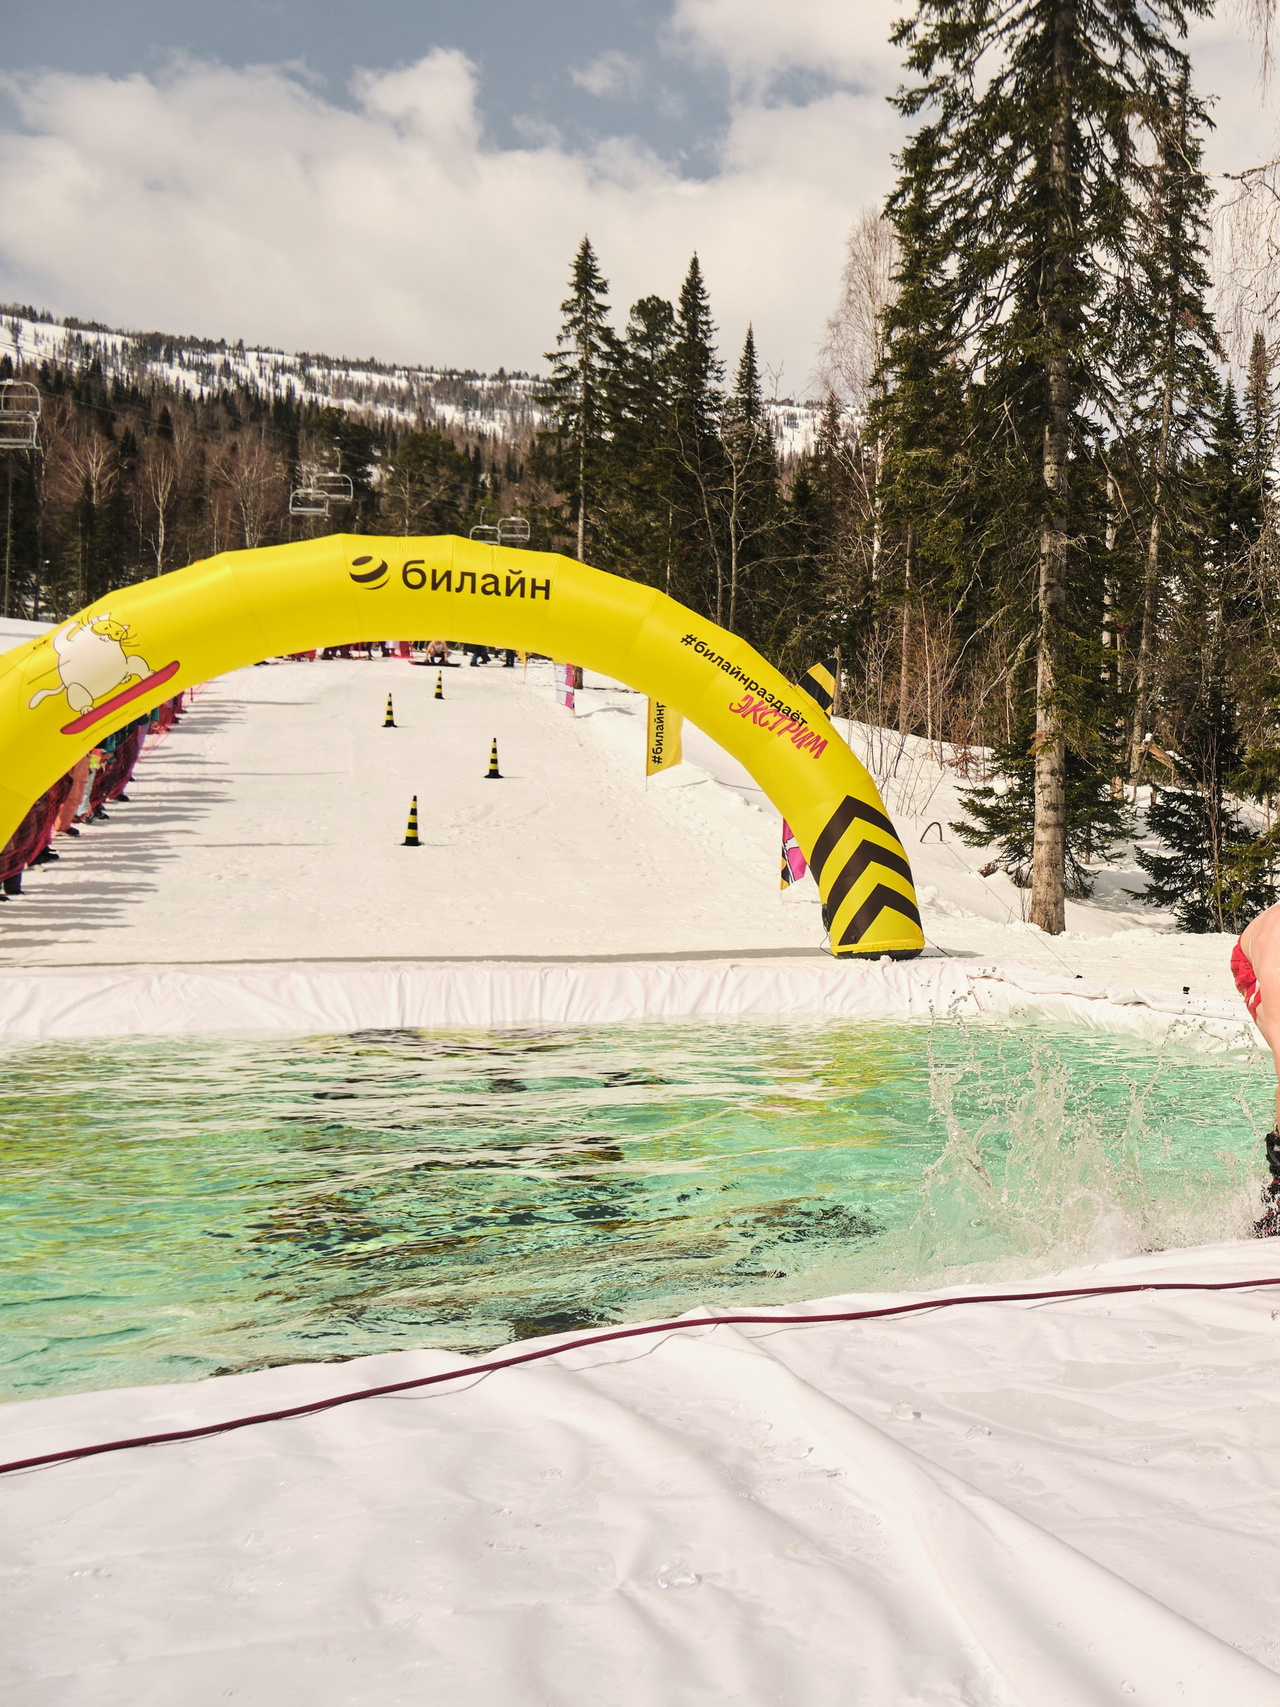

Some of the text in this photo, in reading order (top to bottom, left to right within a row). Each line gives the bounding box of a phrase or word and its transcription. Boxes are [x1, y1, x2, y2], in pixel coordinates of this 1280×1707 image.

[402, 559, 550, 600] билайн
[680, 634, 808, 728] #билайнраздаёт
[728, 694, 829, 760] ЭКСТРИМ
